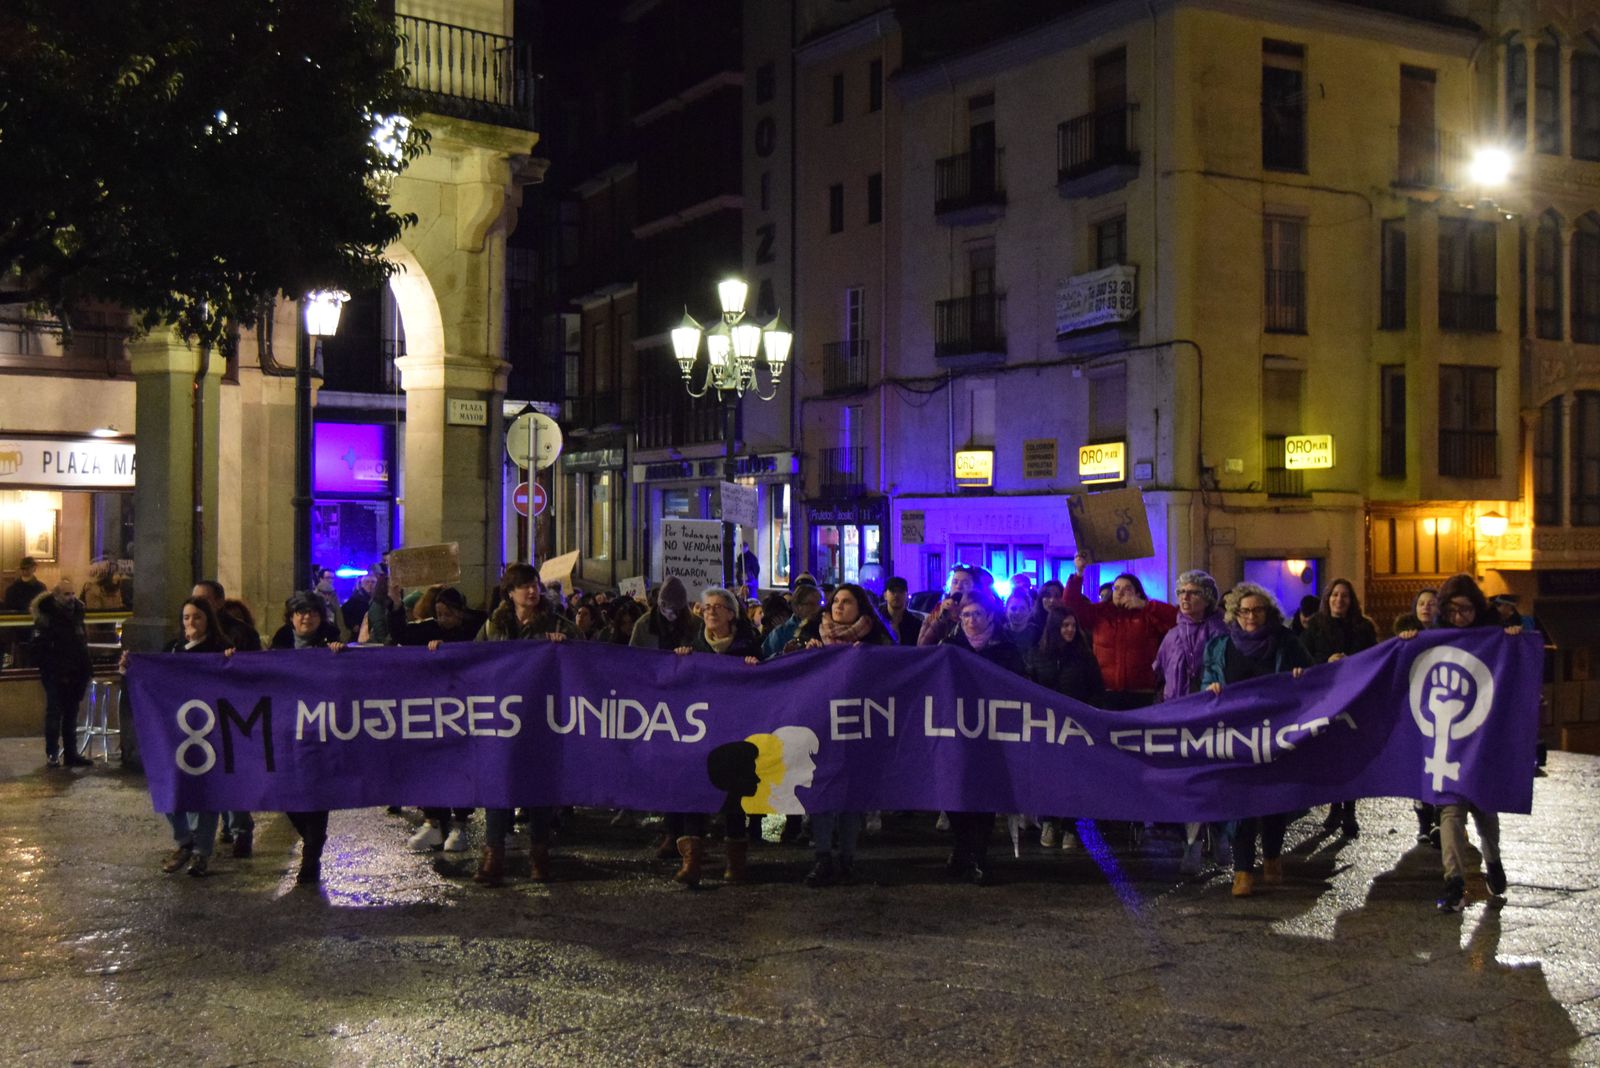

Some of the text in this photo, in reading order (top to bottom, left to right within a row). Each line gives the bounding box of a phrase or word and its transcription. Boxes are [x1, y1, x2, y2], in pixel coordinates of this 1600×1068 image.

[1120, 281, 1132, 294] 30
[461, 403, 483, 411] PLAZA
[460, 412, 484, 421] MAYOR
[1287, 440, 1312, 454] ORO
[43, 450, 102, 475] PLAZA
[957, 456, 975, 469] ORO
[1081, 449, 1103, 465] ORO
[902, 525, 918, 537] ORO
[664, 540, 678, 550] NO
[665, 566, 707, 577] APAGARON
[175, 696, 276, 776] 8M
[295, 695, 523, 743] MUJERES
[829, 696, 896, 741] EN
[924, 695, 1095, 746] LUCHA
